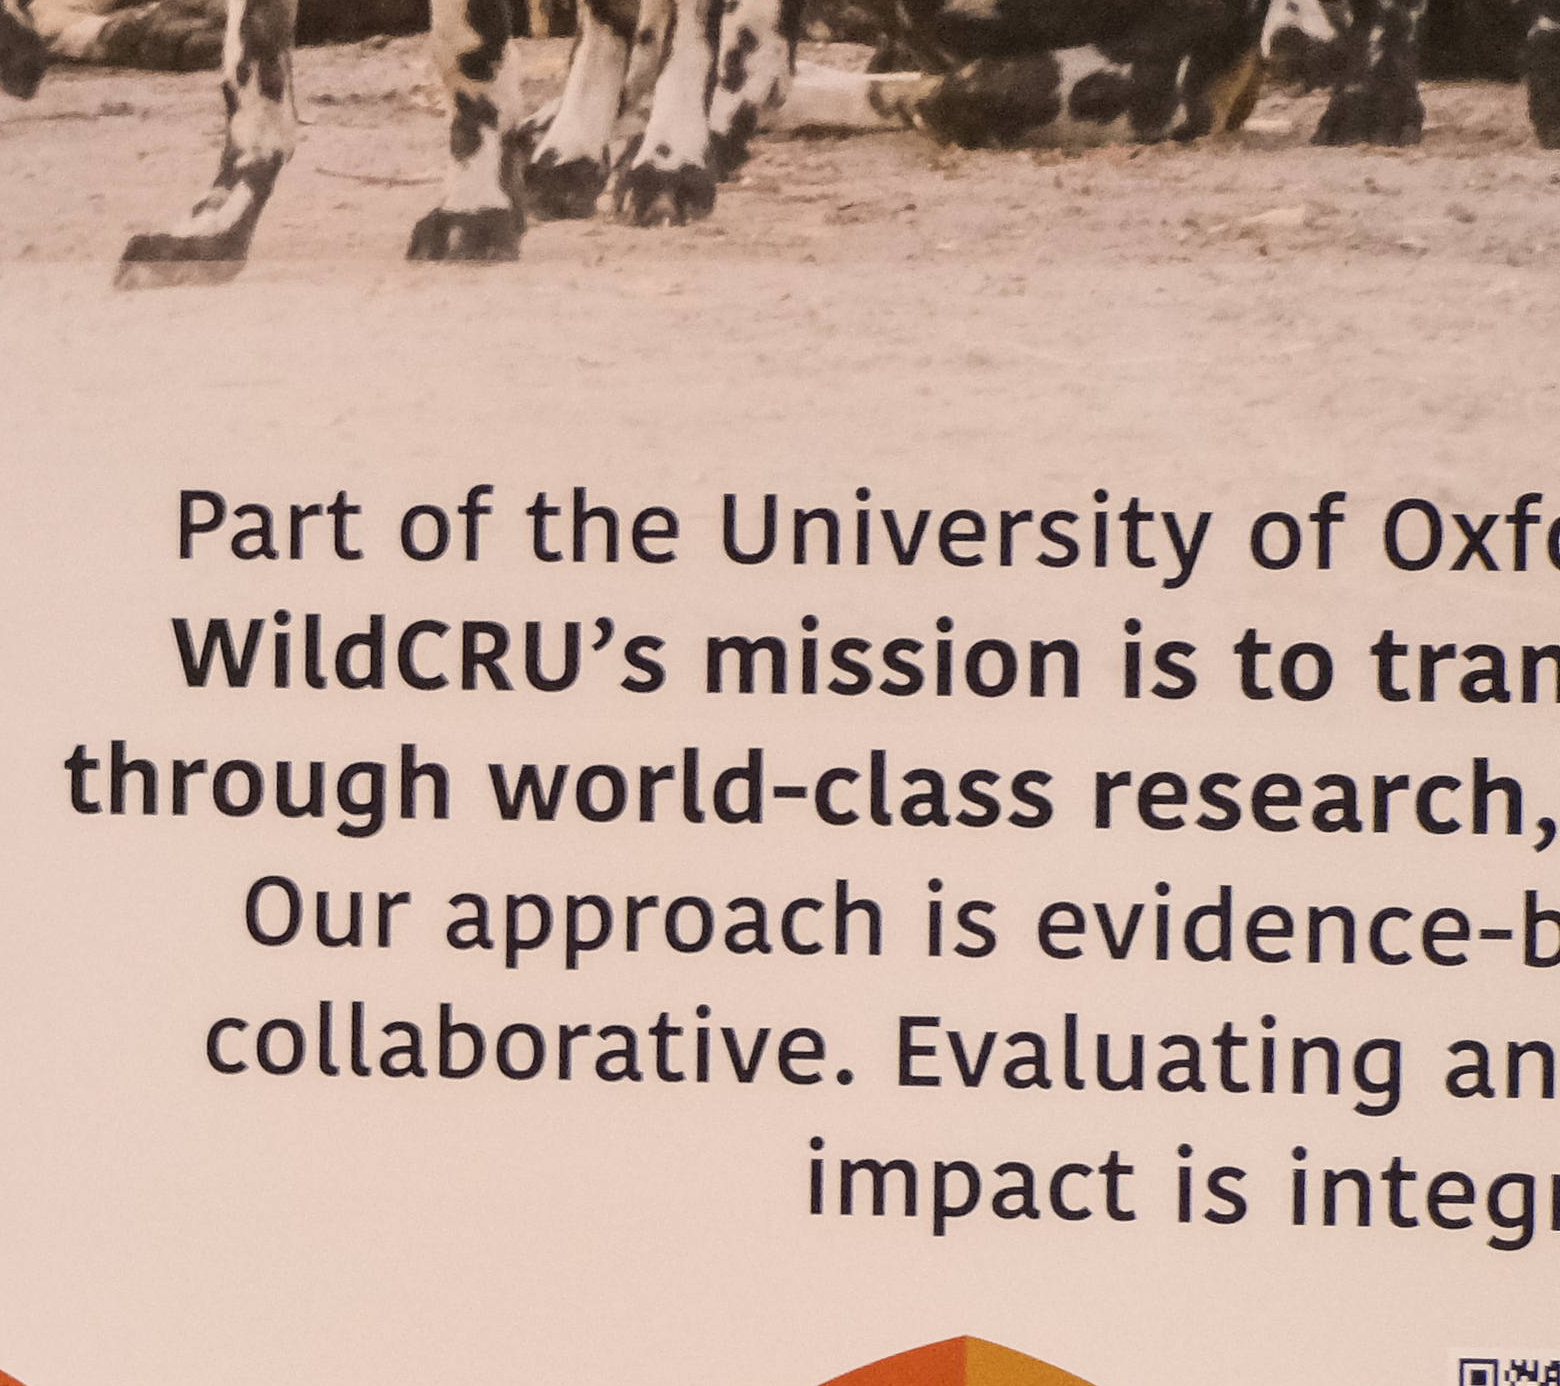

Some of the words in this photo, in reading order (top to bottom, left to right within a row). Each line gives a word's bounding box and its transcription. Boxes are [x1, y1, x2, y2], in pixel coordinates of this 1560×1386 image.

[180, 490, 362, 560] Part
[401, 484, 493, 561] of
[526, 487, 678, 563] the
[723, 487, 1212, 589] University
[1251, 491, 1346, 570] of
[1384, 493, 1560, 571] Oxf
[172, 610, 665, 693] WildCRU’s
[707, 615, 1078, 697] mission
[1125, 618, 1196, 699] is
[1234, 629, 1333, 701] to
[64, 740, 448, 838] through
[489, 748, 1053, 828] world-class
[1096, 758, 1556, 852] research,
[246, 876, 410, 947] Our
[447, 879, 881, 969] approach
[928, 878, 996, 958] is
[207, 1001, 853, 1085] collaborative.
[899, 1013, 1401, 1116] Evaluating
[810, 1136, 1135, 1236] impact
[1178, 1144, 1247, 1224] is
